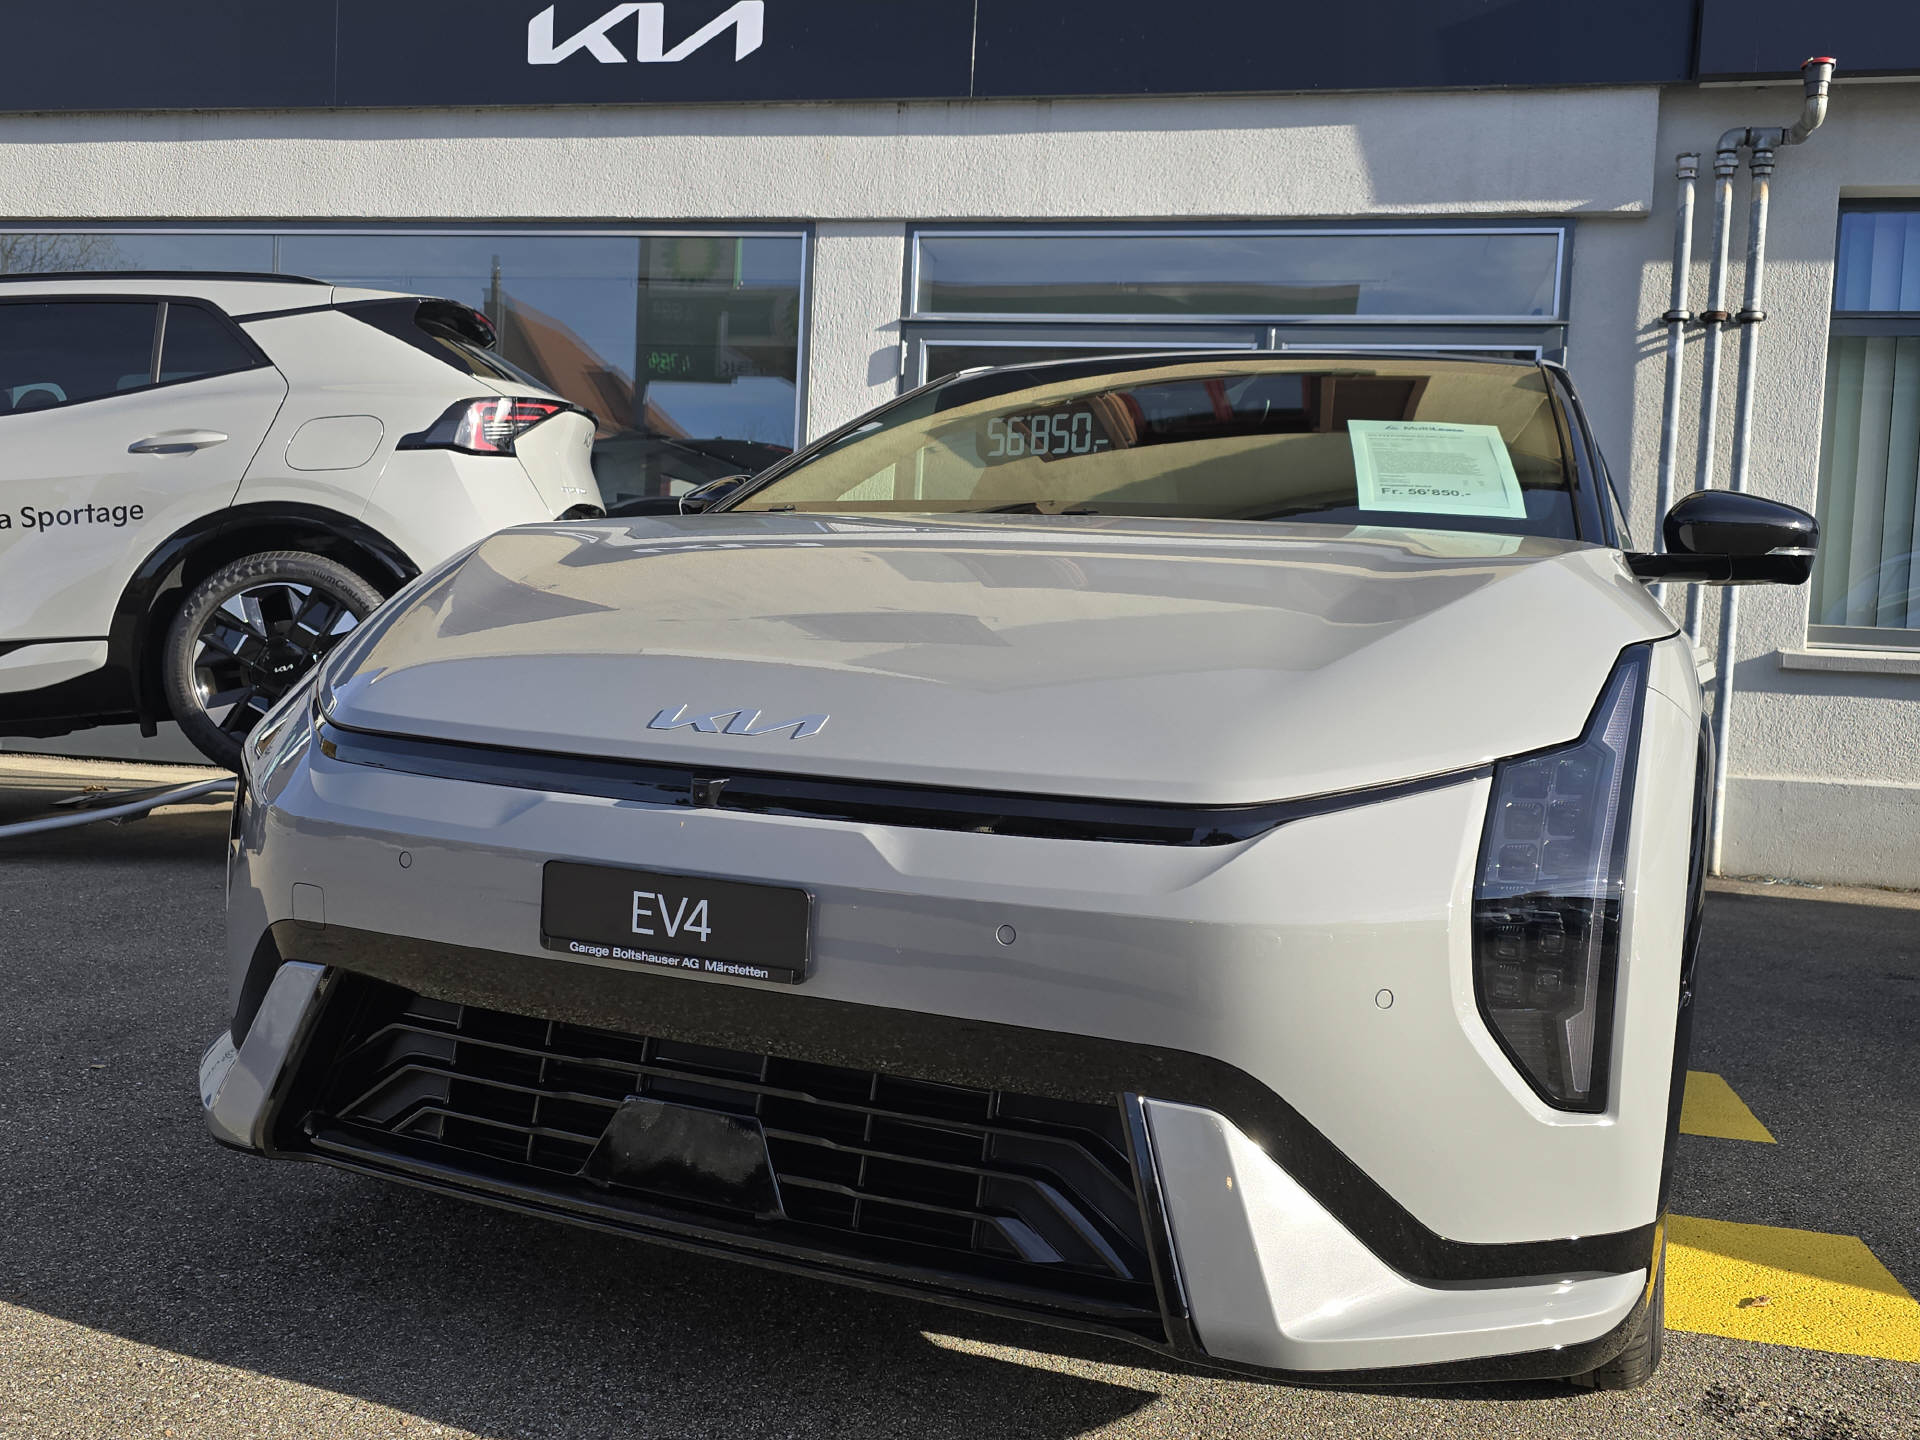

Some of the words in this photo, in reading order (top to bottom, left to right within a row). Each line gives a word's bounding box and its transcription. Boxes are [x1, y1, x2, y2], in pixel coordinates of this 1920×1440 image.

[528, 0, 764, 64] KIA
[1381, 487, 1404, 495] Fr.
[1408, 488, 1471, 497] 56'850.-
[20, 503, 144, 533] Sportage
[646, 703, 830, 740] KIA
[631, 890, 712, 942] EV4
[569, 941, 610, 958] Garage
[612, 946, 679, 967] Boltshauser
[681, 957, 700, 970] AG
[704, 959, 769, 979] Märstetten
